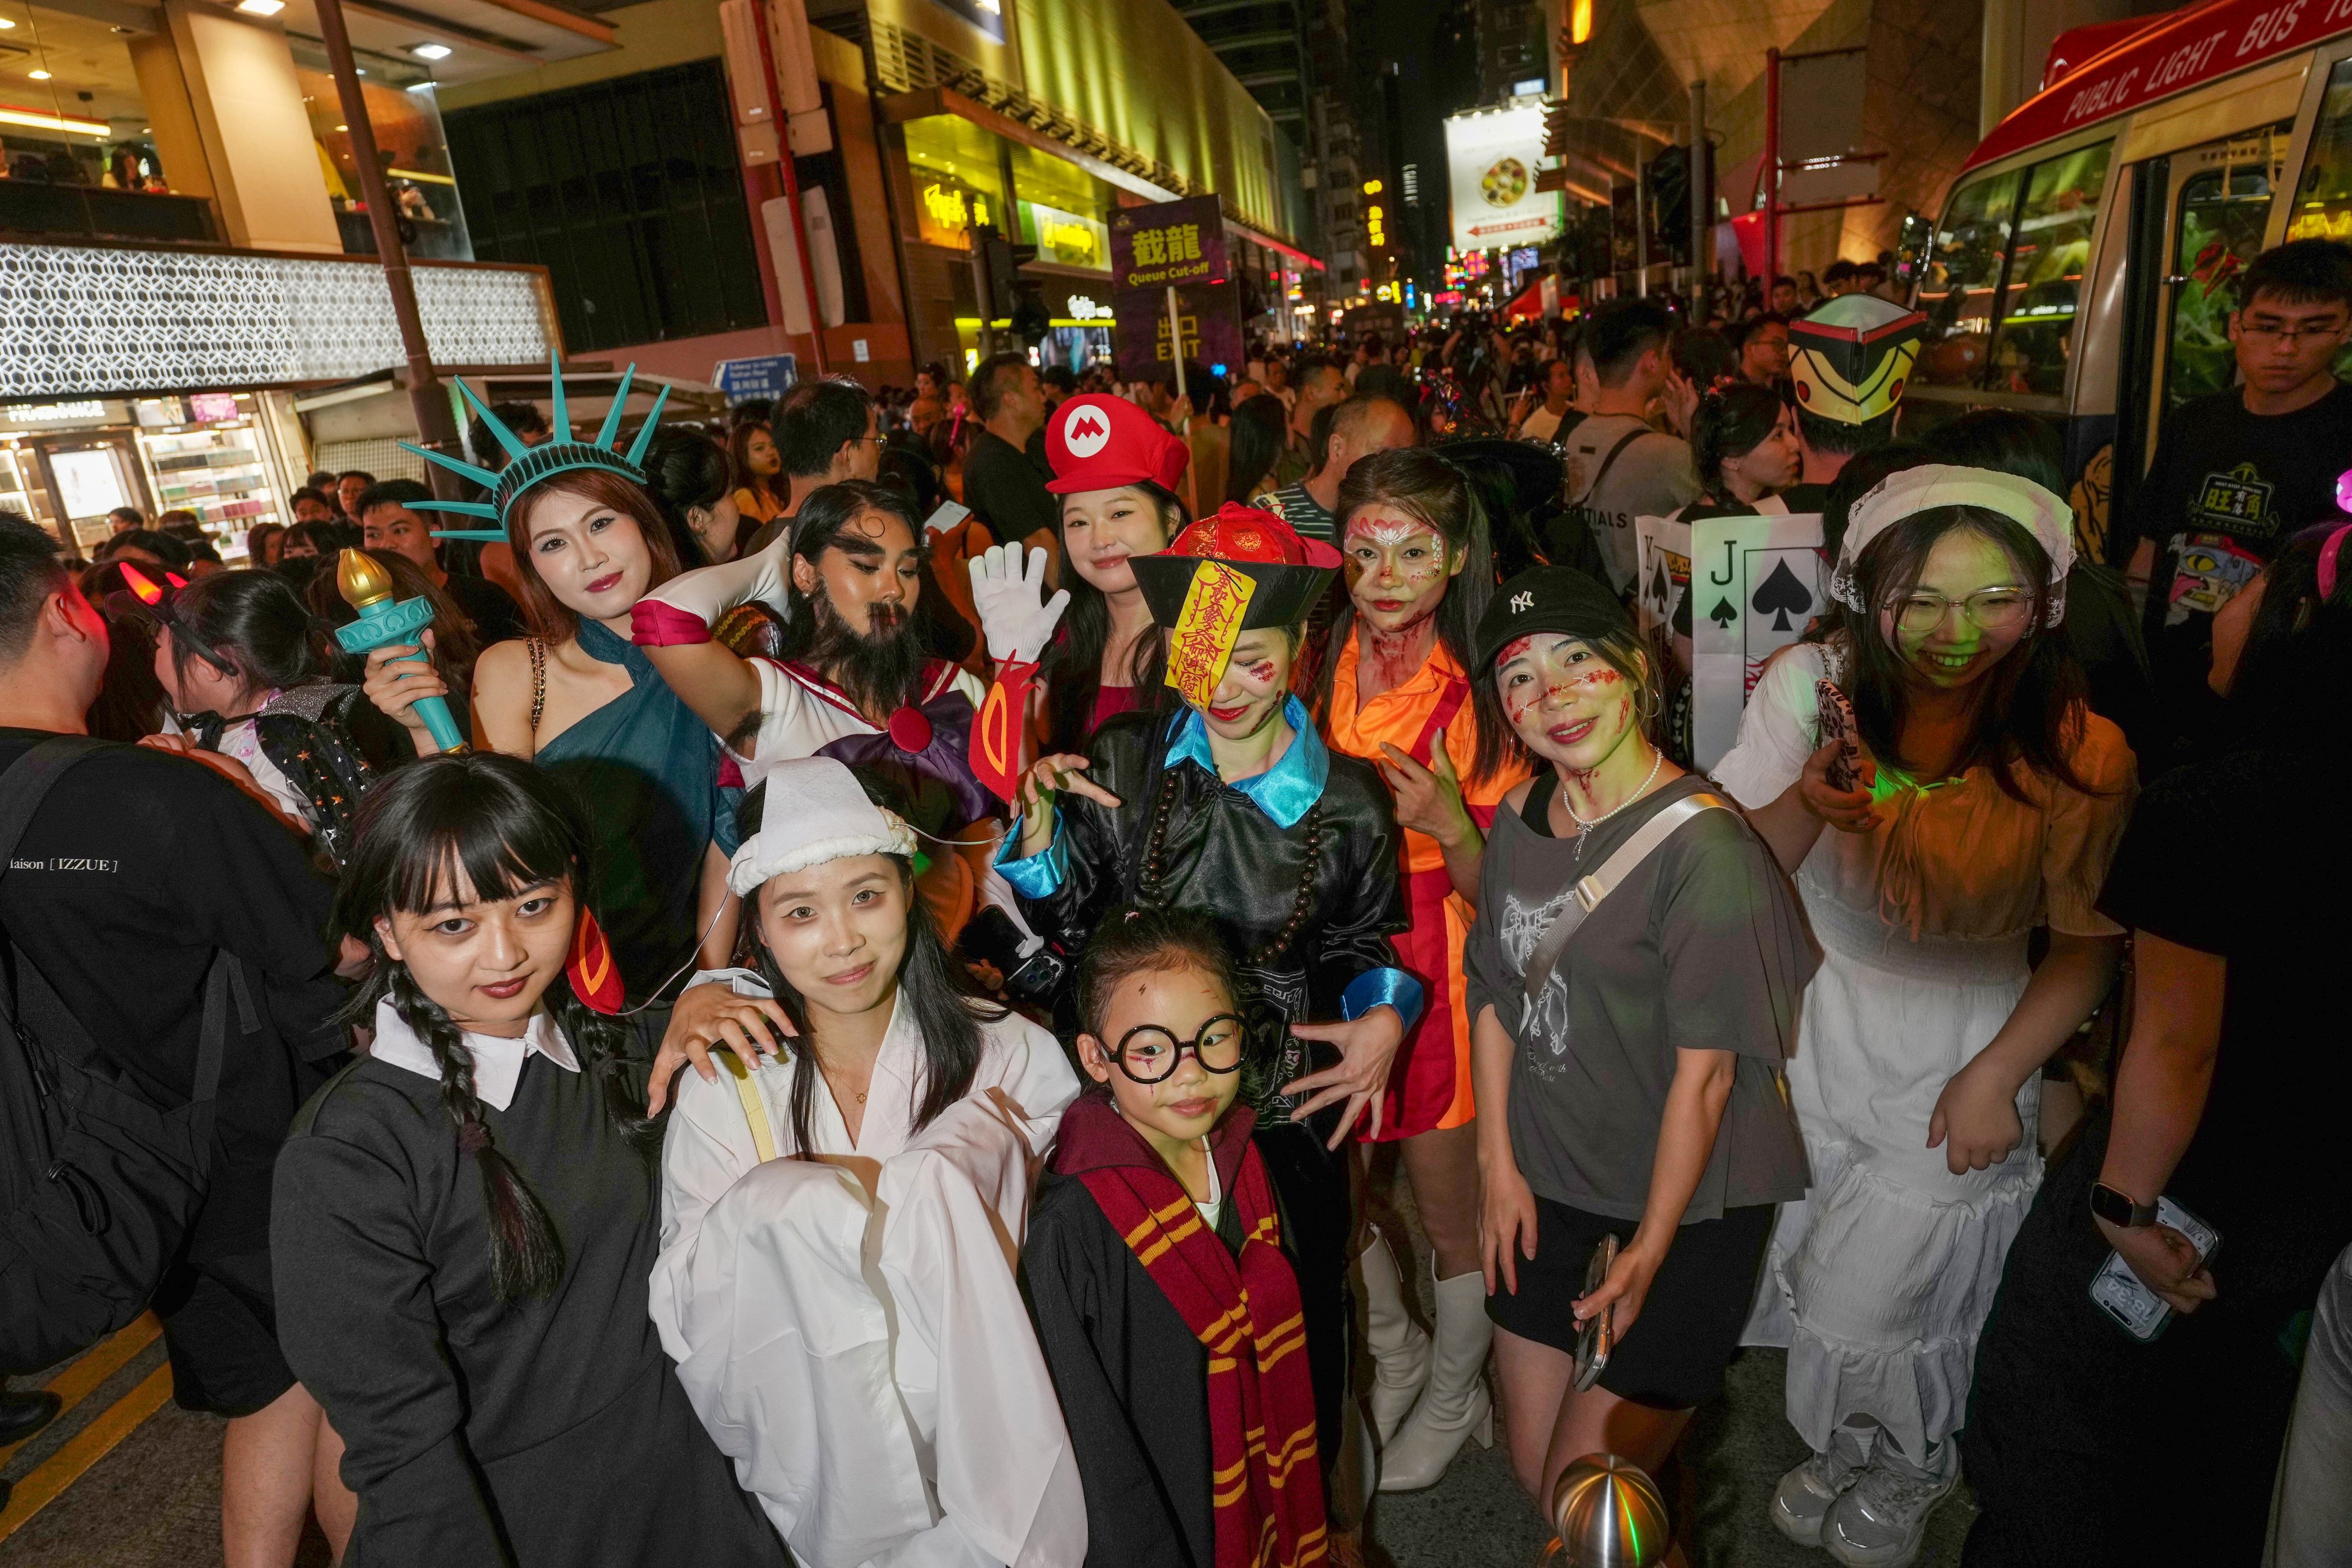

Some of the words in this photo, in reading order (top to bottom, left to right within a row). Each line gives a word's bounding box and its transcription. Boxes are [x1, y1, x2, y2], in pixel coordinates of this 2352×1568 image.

[2063, 67, 2139, 123] PUBLIC
[2144, 30, 2227, 92] LIGHT
[2236, 0, 2307, 57] BUS
[1132, 223, 1202, 267] 截龍
[1128, 271, 1167, 286] Queue
[1168, 261, 1210, 279] Cut-off
[1158, 316, 1198, 339] 出口
[1071, 416, 1104, 441] M
[1583, 507, 1627, 528] TIALS
[1644, 535, 1654, 571] K
[1710, 540, 1737, 585] J
[1510, 590, 1534, 614] NY
